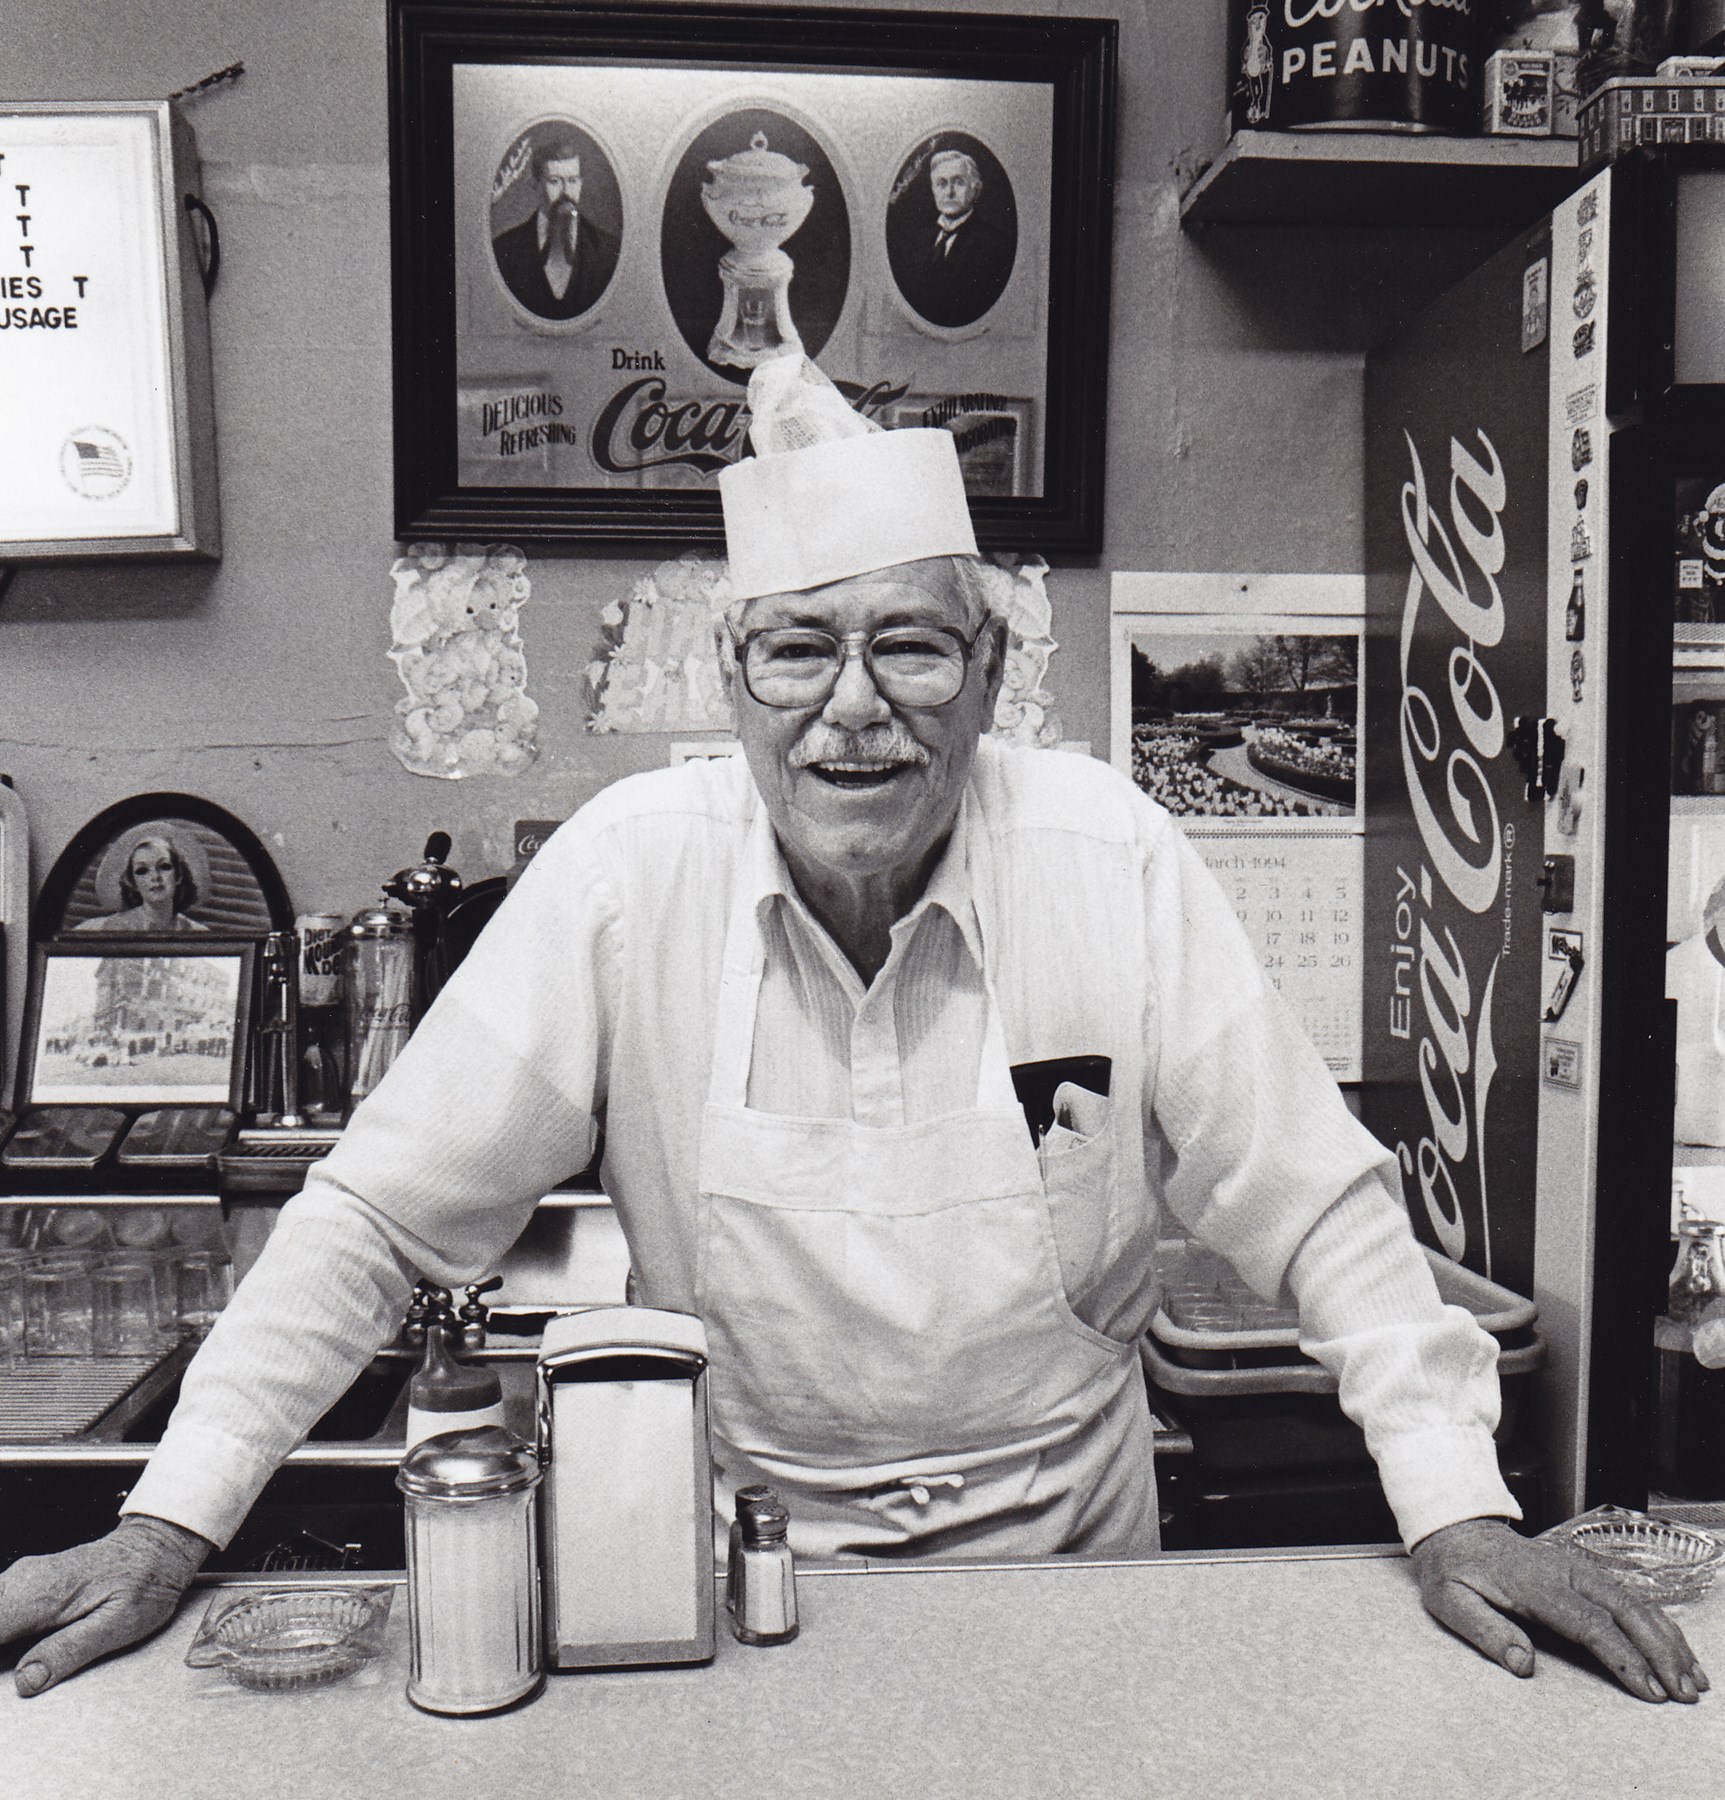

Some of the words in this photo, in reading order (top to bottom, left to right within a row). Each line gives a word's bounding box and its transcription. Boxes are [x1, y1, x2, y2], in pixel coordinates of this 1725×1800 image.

[1282, 38, 1469, 89] PEANUTS
[15, 184, 30, 207] T
[16, 215, 31, 237] T
[19, 245, 34, 268] T
[73, 276, 88, 299] T
[612, 348, 666, 370] Drink
[483, 393, 563, 436] DELICIOUS
[500, 423, 576, 456] REFRESHING
[1205, 856, 1245, 870] arch
[1252, 856, 1286, 870] 1994
[1236, 887, 1247, 900] 2
[1268, 887, 1280, 900] 3
[1304, 887, 1313, 900] 4
[1335, 887, 1347, 900] 5
[1266, 910, 1282, 922] 10
[1301, 909, 1314, 922] 11
[1333, 909, 1349, 922] 12
[1266, 932, 1282, 945] 17
[1300, 932, 1316, 945] 18
[1333, 932, 1350, 945] 19
[1263, 955, 1284, 968] 24
[1298, 955, 1318, 968] 25
[1330, 955, 1351, 968] 26
[1390, 865, 1417, 1040] Enjoy
